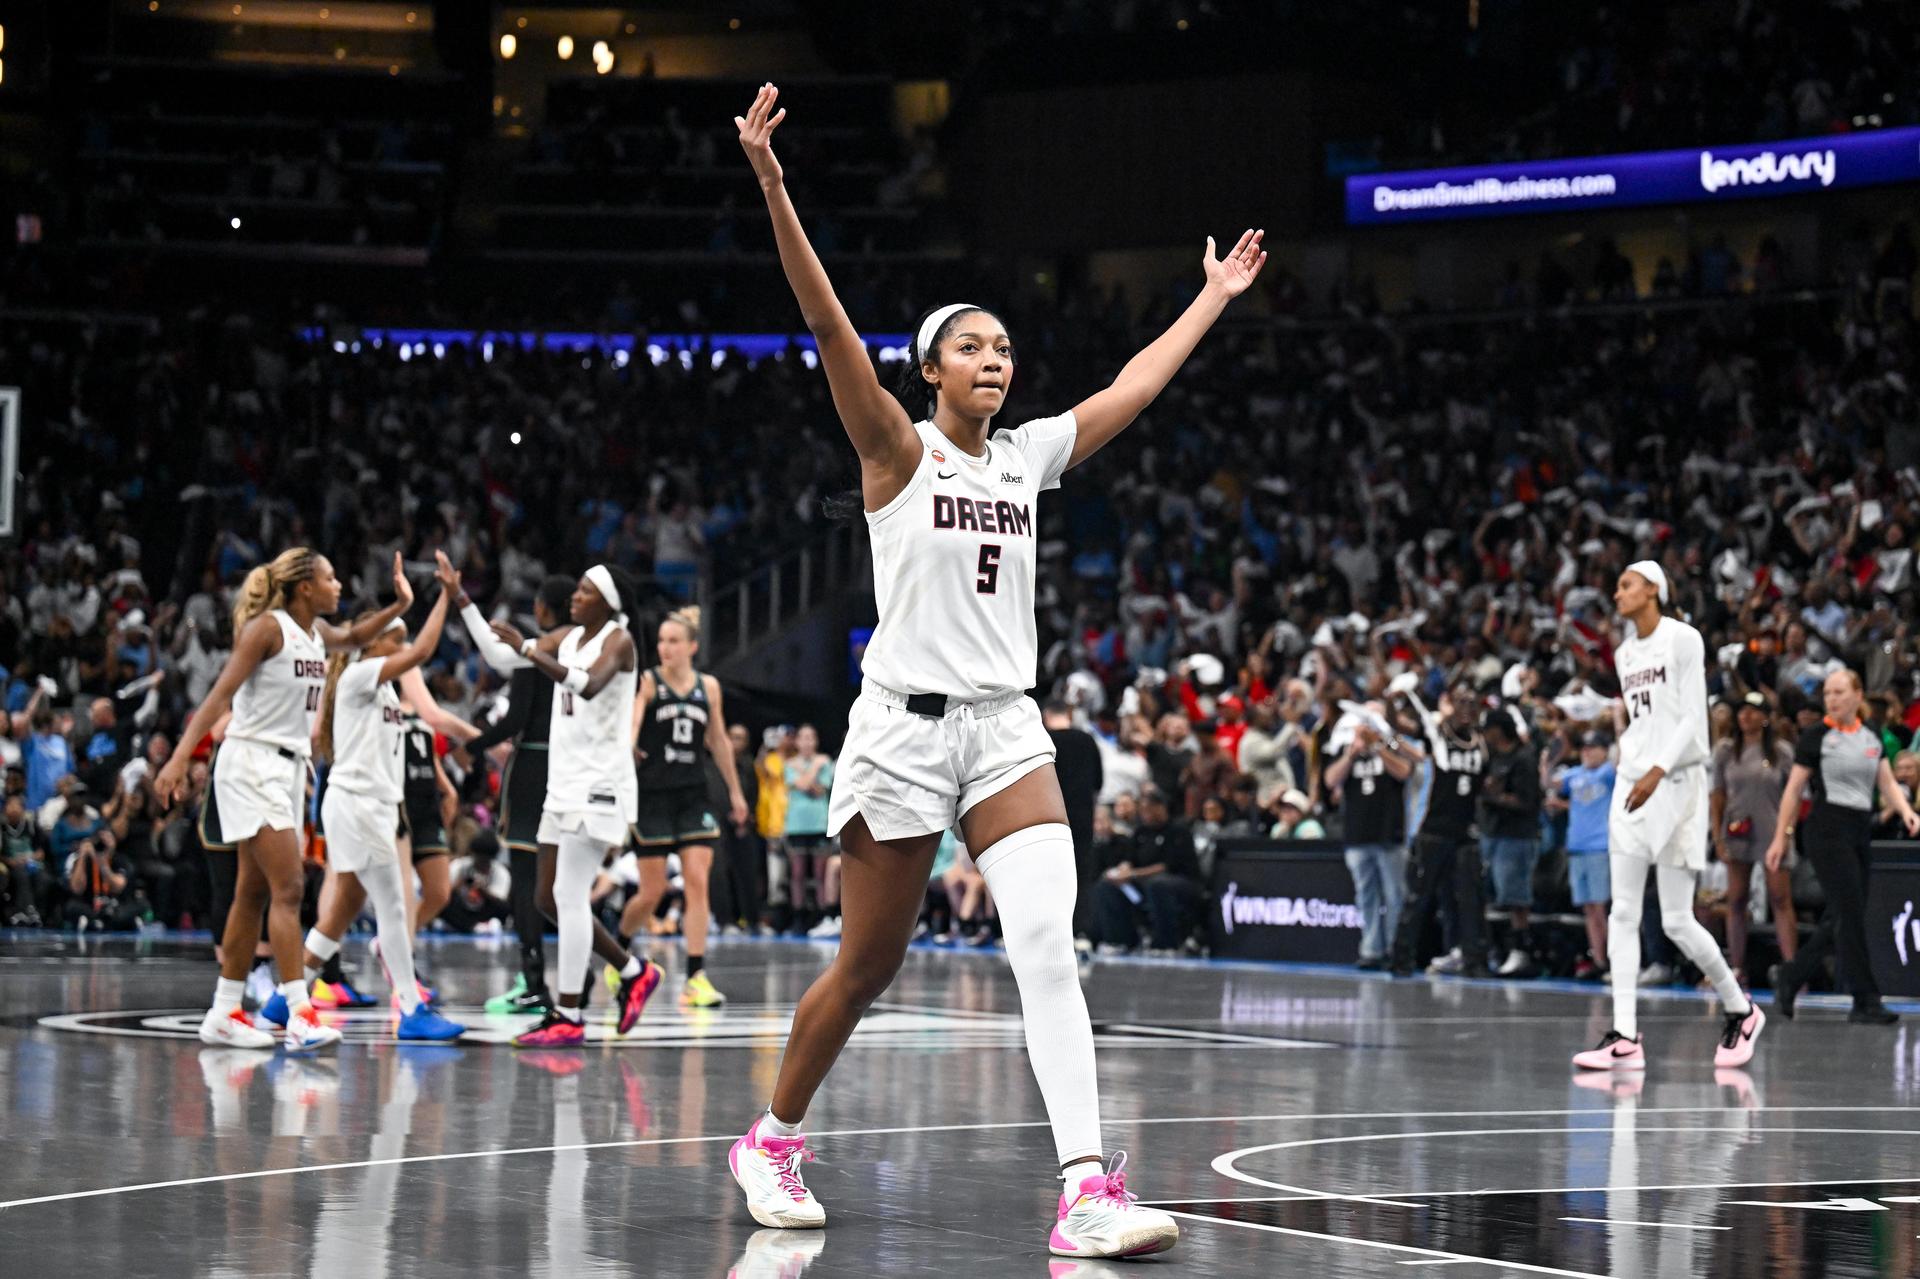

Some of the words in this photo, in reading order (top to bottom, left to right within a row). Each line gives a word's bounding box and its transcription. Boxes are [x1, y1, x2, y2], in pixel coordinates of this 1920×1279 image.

[1373, 174, 1617, 212] DreamSmallBusiness.com
[932, 494, 1032, 538] DREAM
[977, 543, 1002, 595] 5
[294, 659, 325, 679] DREA
[383, 705, 403, 725] DRE
[1631, 689, 1652, 719] 24
[410, 732, 428, 759] 4
[672, 717, 694, 745] 13
